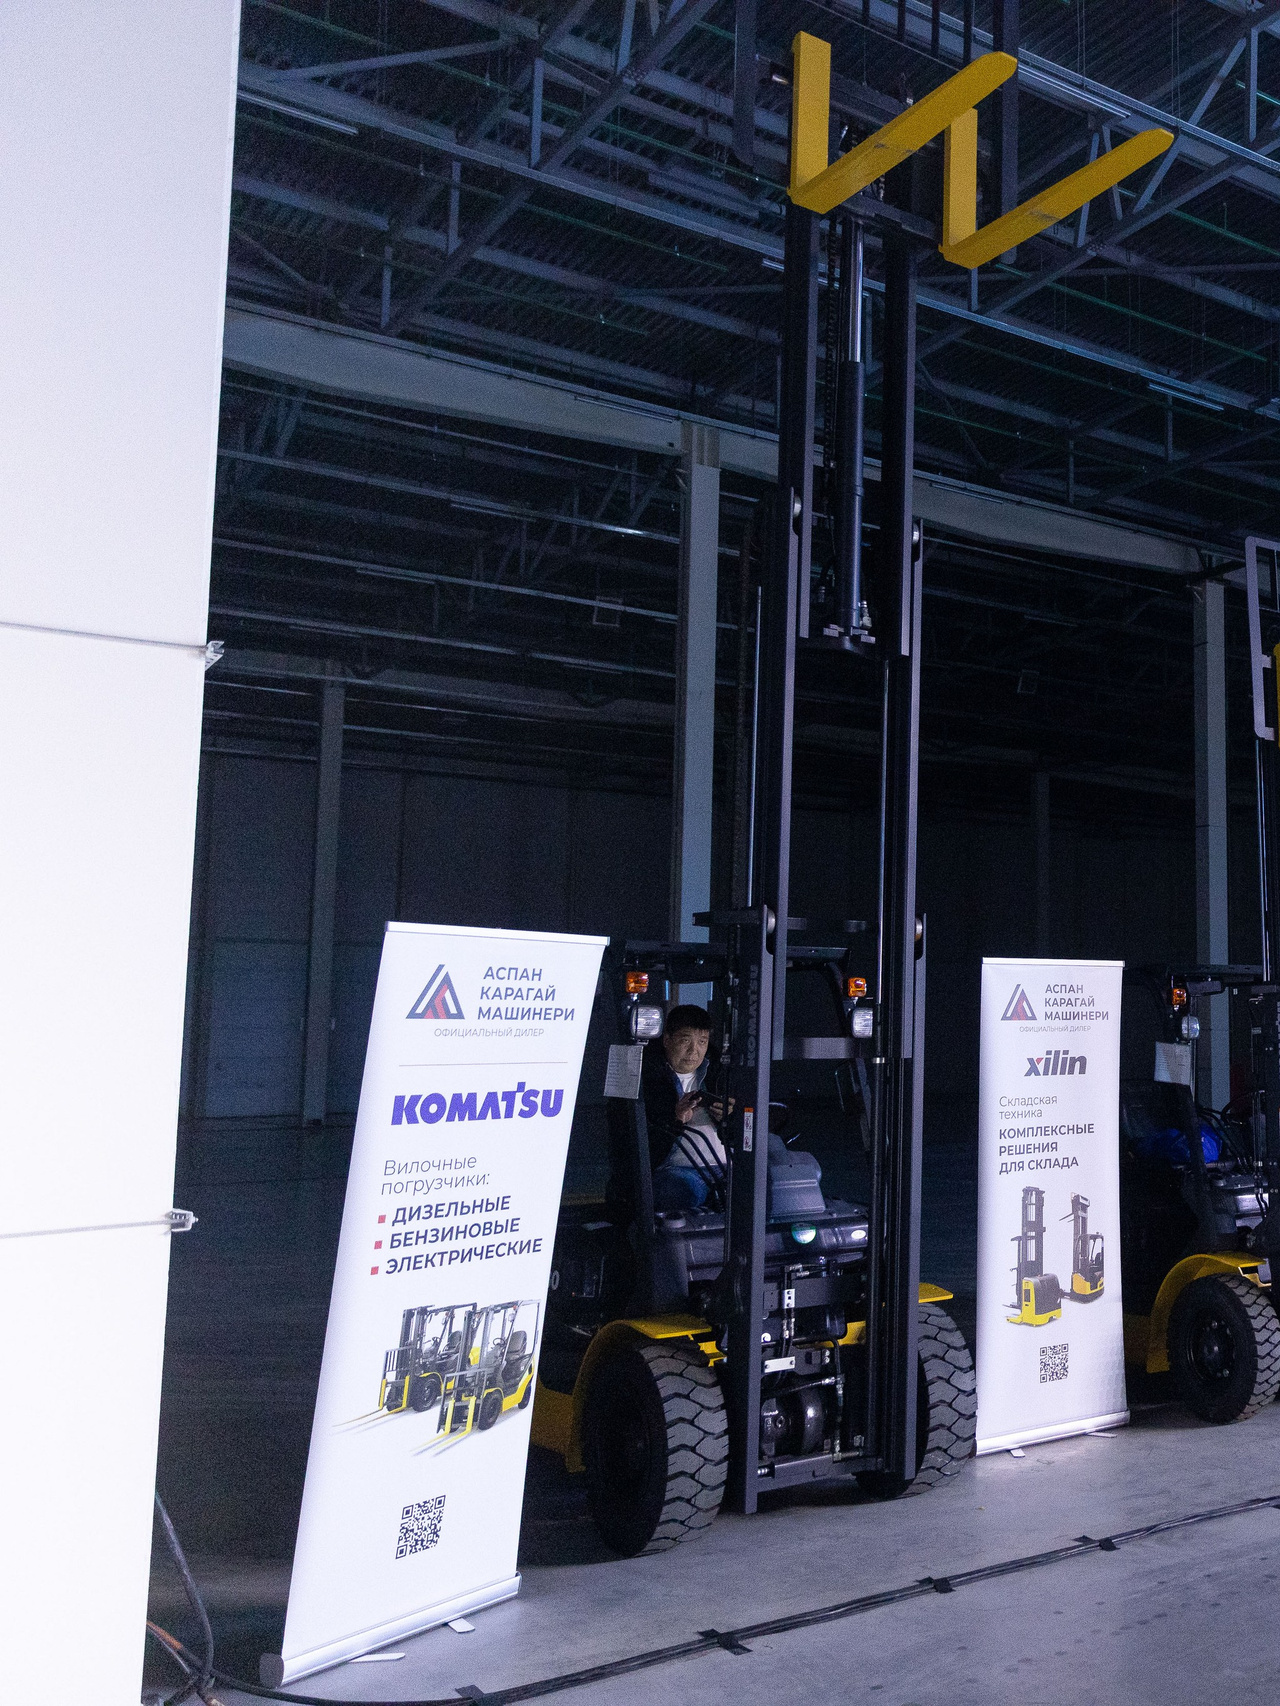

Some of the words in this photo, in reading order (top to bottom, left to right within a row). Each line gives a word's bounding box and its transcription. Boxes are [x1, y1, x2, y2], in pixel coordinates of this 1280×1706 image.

[483, 967, 542, 982] АСПАН
[480, 985, 556, 1002] КАРАГАЙ
[1045, 984, 1083, 994] АСПАН
[1044, 995, 1095, 1008] КАРАГАЙ
[478, 1007, 575, 1021] МАШИНЕРИ
[747, 965, 759, 1067] KOMATSU
[1044, 1008, 1109, 1021] МАШИНЕРИ
[434, 1027, 512, 1038] ОФИЦИАЛЬНЫЙ
[514, 1028, 544, 1038] ДИЛЕР
[1019, 1025, 1067, 1033] ОФИЦИАЛЬНЫЙ
[1024, 1050, 1087, 1077] xilin
[391, 1082, 564, 1125] KOMATSU
[999, 1095, 1057, 1108] Складская
[999, 1107, 1043, 1120] техника
[999, 1124, 1095, 1140] КОМПЛЕКСНЫЕ
[999, 1142, 1058, 1157] РЕШЕНИЯ
[384, 1155, 477, 1176] Вилочные
[999, 1159, 1024, 1175] ДЛЯ
[1028, 1157, 1079, 1174] СКЛАДА
[381, 1172, 490, 1196] погрузчики:
[392, 1195, 511, 1226] ДИЗЕЛЬНЫЕ
[390, 1218, 520, 1249] БЕНЗИНОВЫЕ
[386, 1238, 543, 1274] ЭЛЕКТРИЧЕСКИЕ
